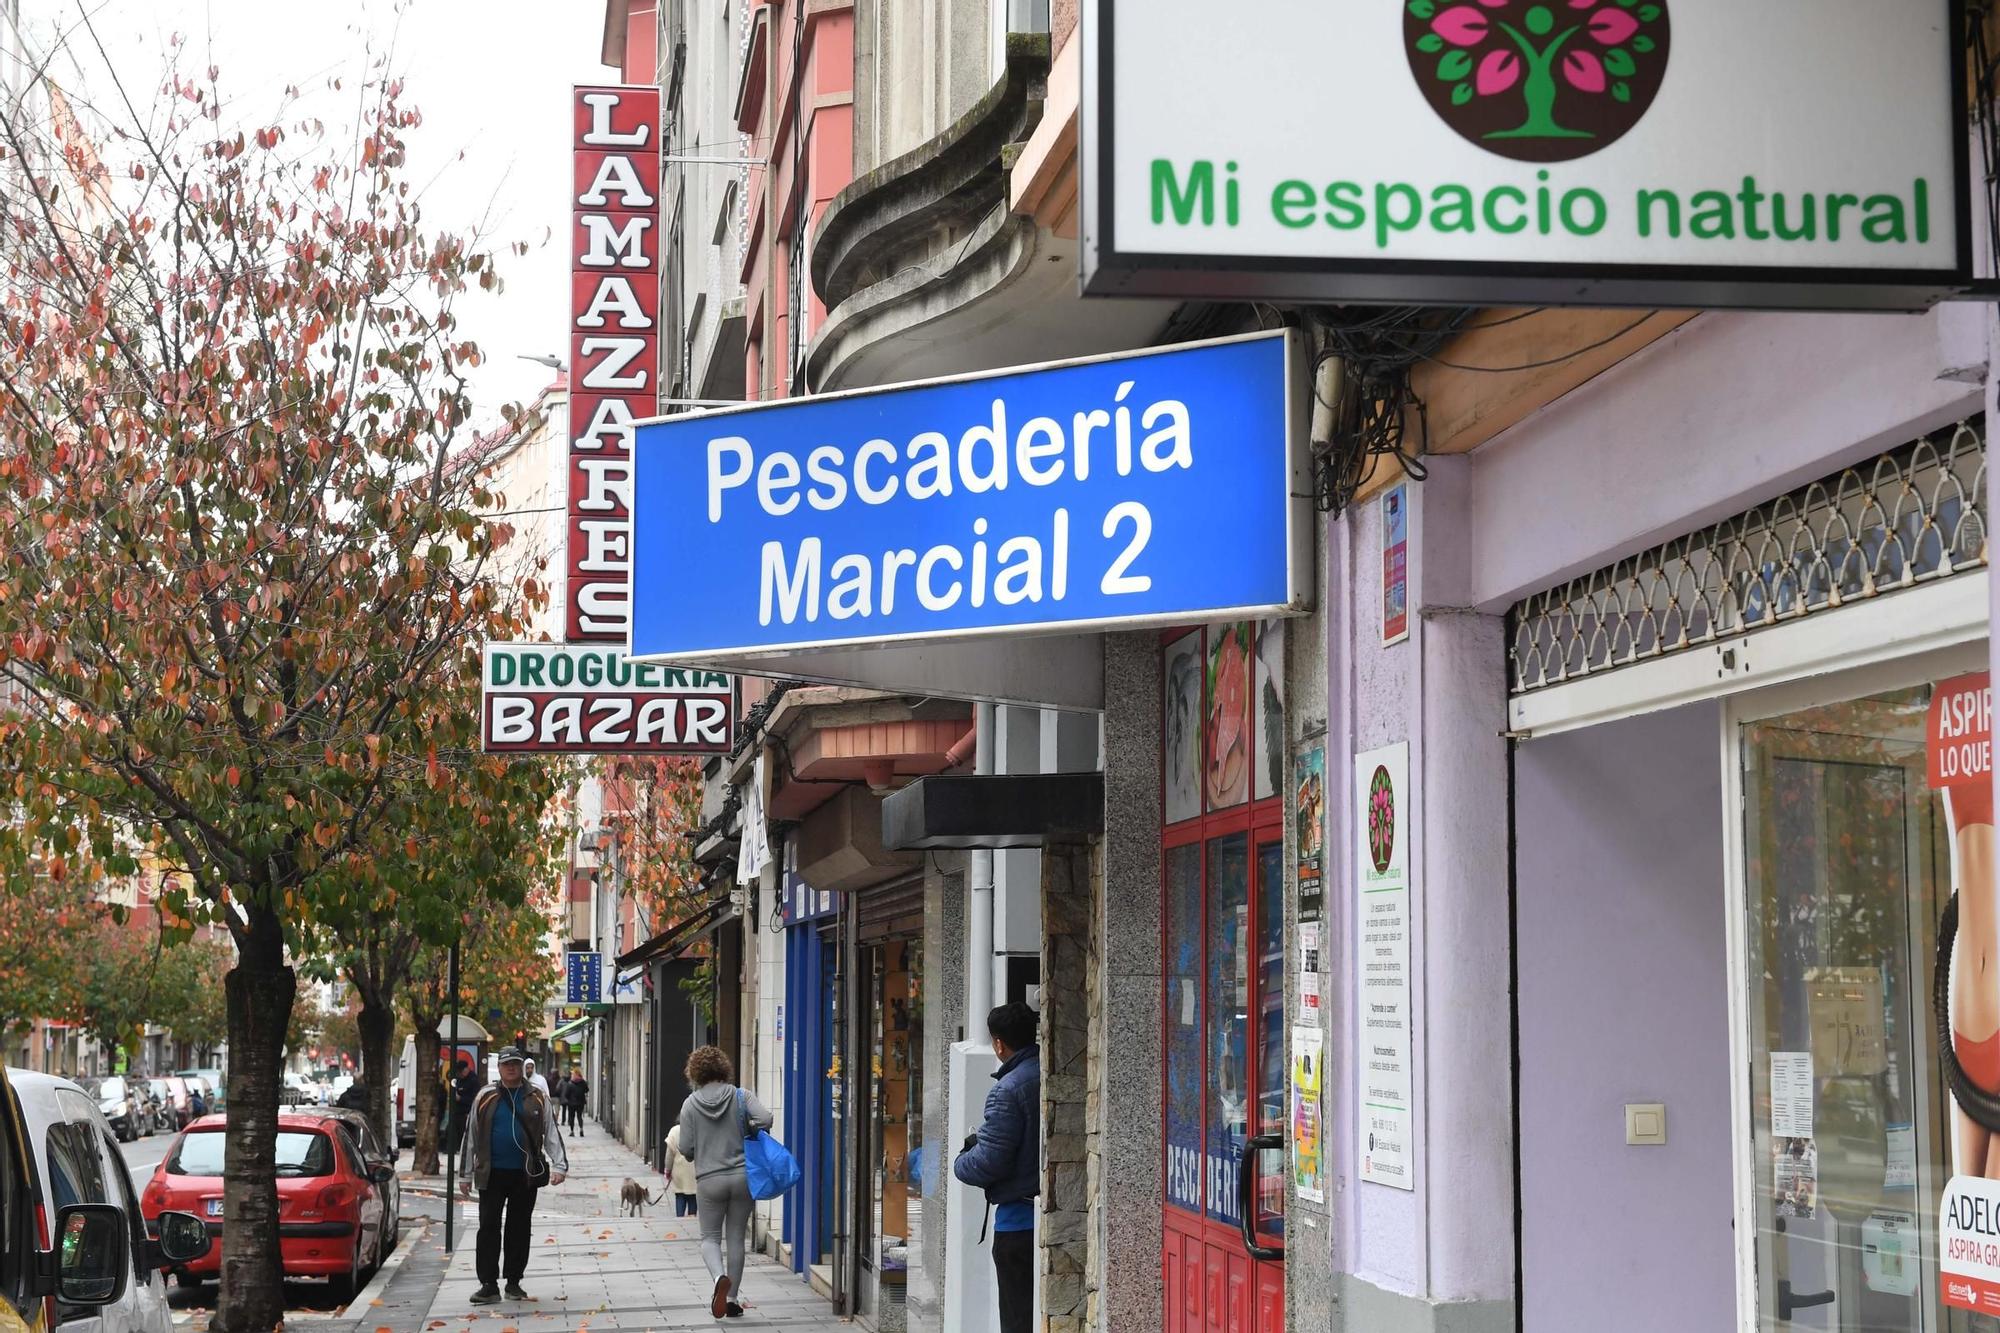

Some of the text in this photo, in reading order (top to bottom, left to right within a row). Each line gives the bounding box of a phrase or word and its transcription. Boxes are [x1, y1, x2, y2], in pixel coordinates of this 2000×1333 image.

[1149, 159, 1930, 248] Mi espacio natural
[574, 93, 655, 633] LAMAZARES
[706, 380, 1193, 524] Pescadería
[758, 501, 1153, 627] Marcial 2
[491, 697, 727, 744] BAZAR
[1939, 741, 1992, 778] LO QUE
[580, 955, 590, 1001] MITOS
[1948, 1236, 2000, 1268] ASPIRA GR
